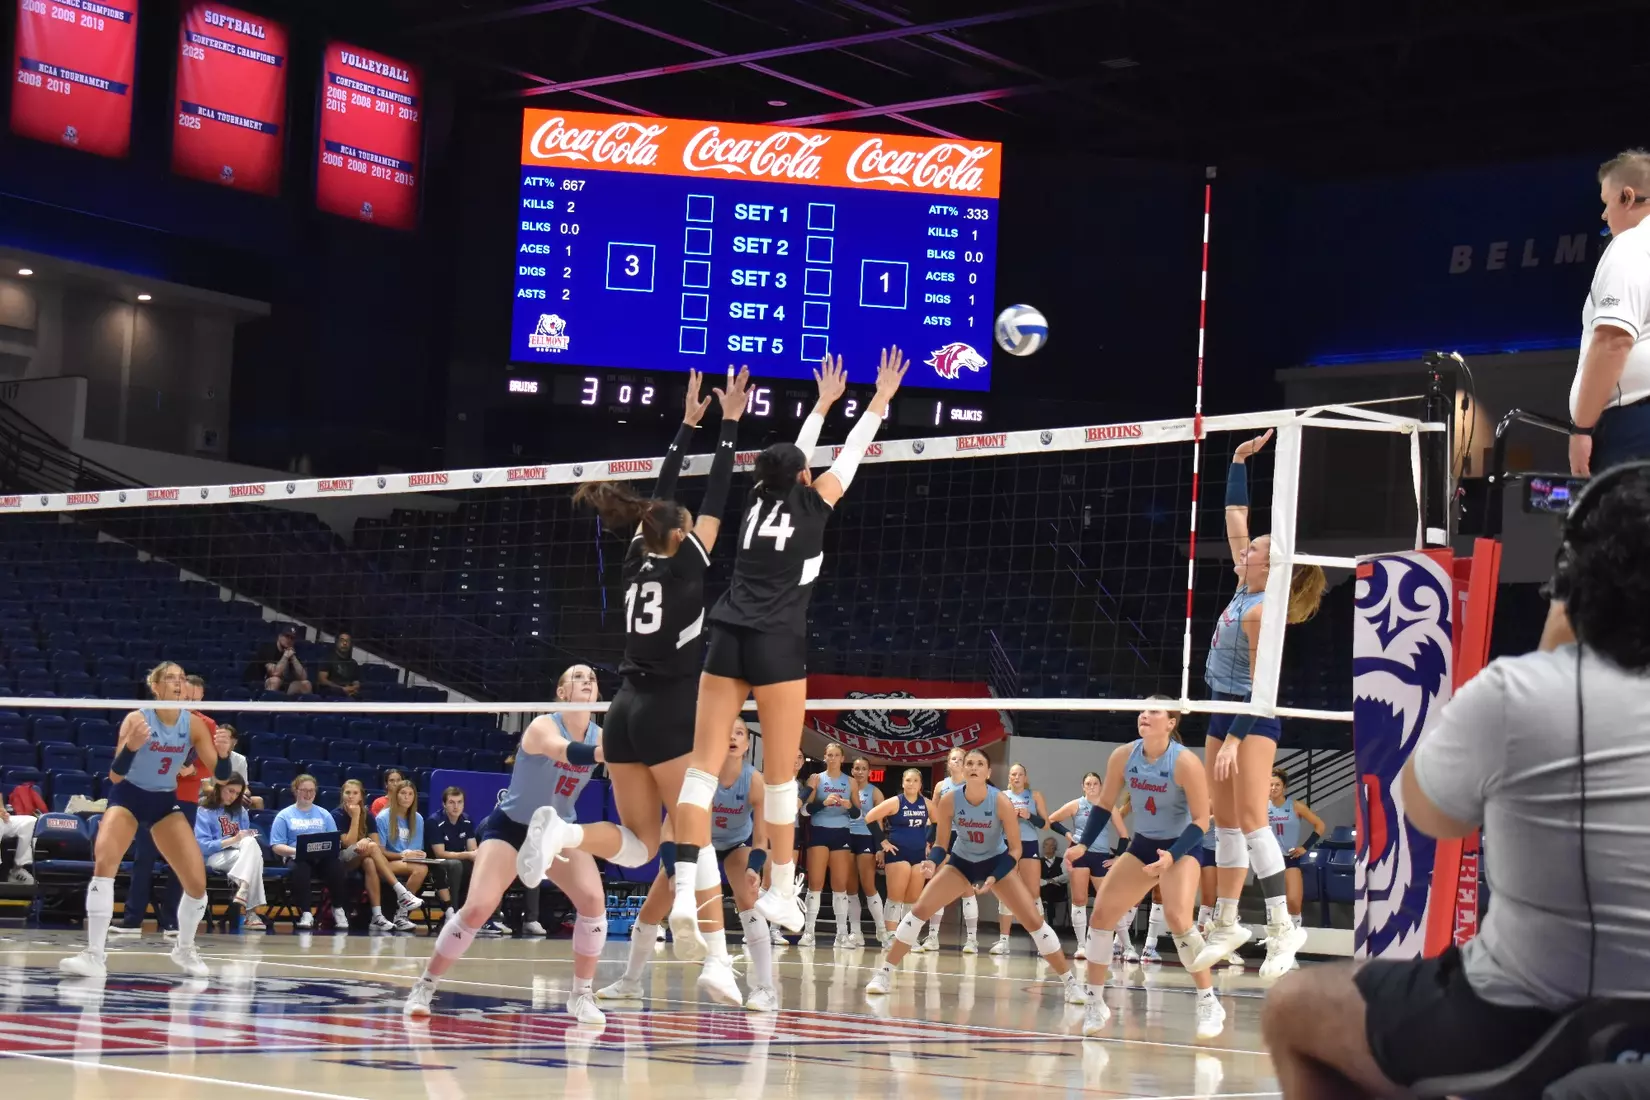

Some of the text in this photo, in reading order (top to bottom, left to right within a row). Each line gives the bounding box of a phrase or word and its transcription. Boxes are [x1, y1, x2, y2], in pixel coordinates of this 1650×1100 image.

[52, 6, 75, 23] 2009
[80, 14, 104, 31] 2019
[82, 1, 124, 20] CHAMPIONS
[204, 10, 265, 39] SOFTBALL
[182, 44, 205, 61] 2025
[192, 34, 276, 64] CONFERENCE CHAMPIONS
[341, 51, 409, 82] VOLLEYBALL
[38, 63, 110, 90] NCAA TOURNAMENT
[47, 78, 71, 95] 2019
[335, 76, 412, 105] CONFERENCE CHAMPIONS
[326, 99, 346, 113] 2015
[327, 86, 418, 121] 2006 2008 2011 2012
[179, 113, 201, 130] 2025
[198, 106, 263, 131] NCAA TOURNAMENT
[340, 145, 400, 169] NCAA TOURNAMENT
[530, 117, 992, 191] Coca-Cola Coca-Cola Coca-Cola
[322, 152, 414, 186] 2006 2008 2012 2015
[523, 176, 586, 191] ATT% .667
[522, 198, 575, 213] KILLS 2
[734, 203, 788, 223] SET 1
[928, 205, 989, 221] ATT% .333
[521, 221, 580, 235] BLKS 0.0
[927, 227, 978, 241] KILLS 1
[520, 244, 571, 256] ACES 1
[732, 236, 789, 256] SET 2
[1449, 233, 1588, 274] BELM
[624, 254, 640, 276] 3
[926, 249, 983, 263] BLKS 0.0
[519, 265, 571, 279] DIGS 2
[731, 269, 787, 288] SET 3
[925, 272, 977, 284] ACES 0
[879, 272, 889, 293] 1
[517, 288, 570, 300] ASTS 2
[924, 293, 975, 306] DIGS 1
[729, 302, 785, 321] SET 4
[923, 316, 973, 328] ASTS 1
[727, 335, 783, 354] SET 5
[509, 379, 538, 393] BRUINS
[582, 377, 599, 405] 3
[619, 385, 631, 404] 0
[641, 387, 654, 405] 2
[797, 400, 983, 425] 1 2 1 SALUKIS
[66, 493, 100, 505] BRUINS
[147, 489, 179, 501] BELMONT
[229, 484, 265, 498] BRUINS
[317, 479, 354, 492] BELMONT
[408, 472, 448, 488] BRUINS
[506, 467, 548, 482] BELMONT
[608, 459, 653, 474] BRUINS
[956, 433, 1007, 452] BELMONT
[1085, 424, 1143, 443] BRUINS
[743, 497, 795, 551] 14
[625, 581, 663, 635] 13
[149, 741, 186, 753] Belmont
[817, 719, 980, 757] BELMONT
[157, 757, 173, 775] 3
[555, 775, 580, 797] 15
[1129, 777, 1168, 793] Belmont
[1144, 796, 1157, 815] 4
[715, 816, 728, 829] 2
[908, 819, 923, 827] 12
[959, 817, 992, 829] Belmont
[967, 830, 985, 844] 10
